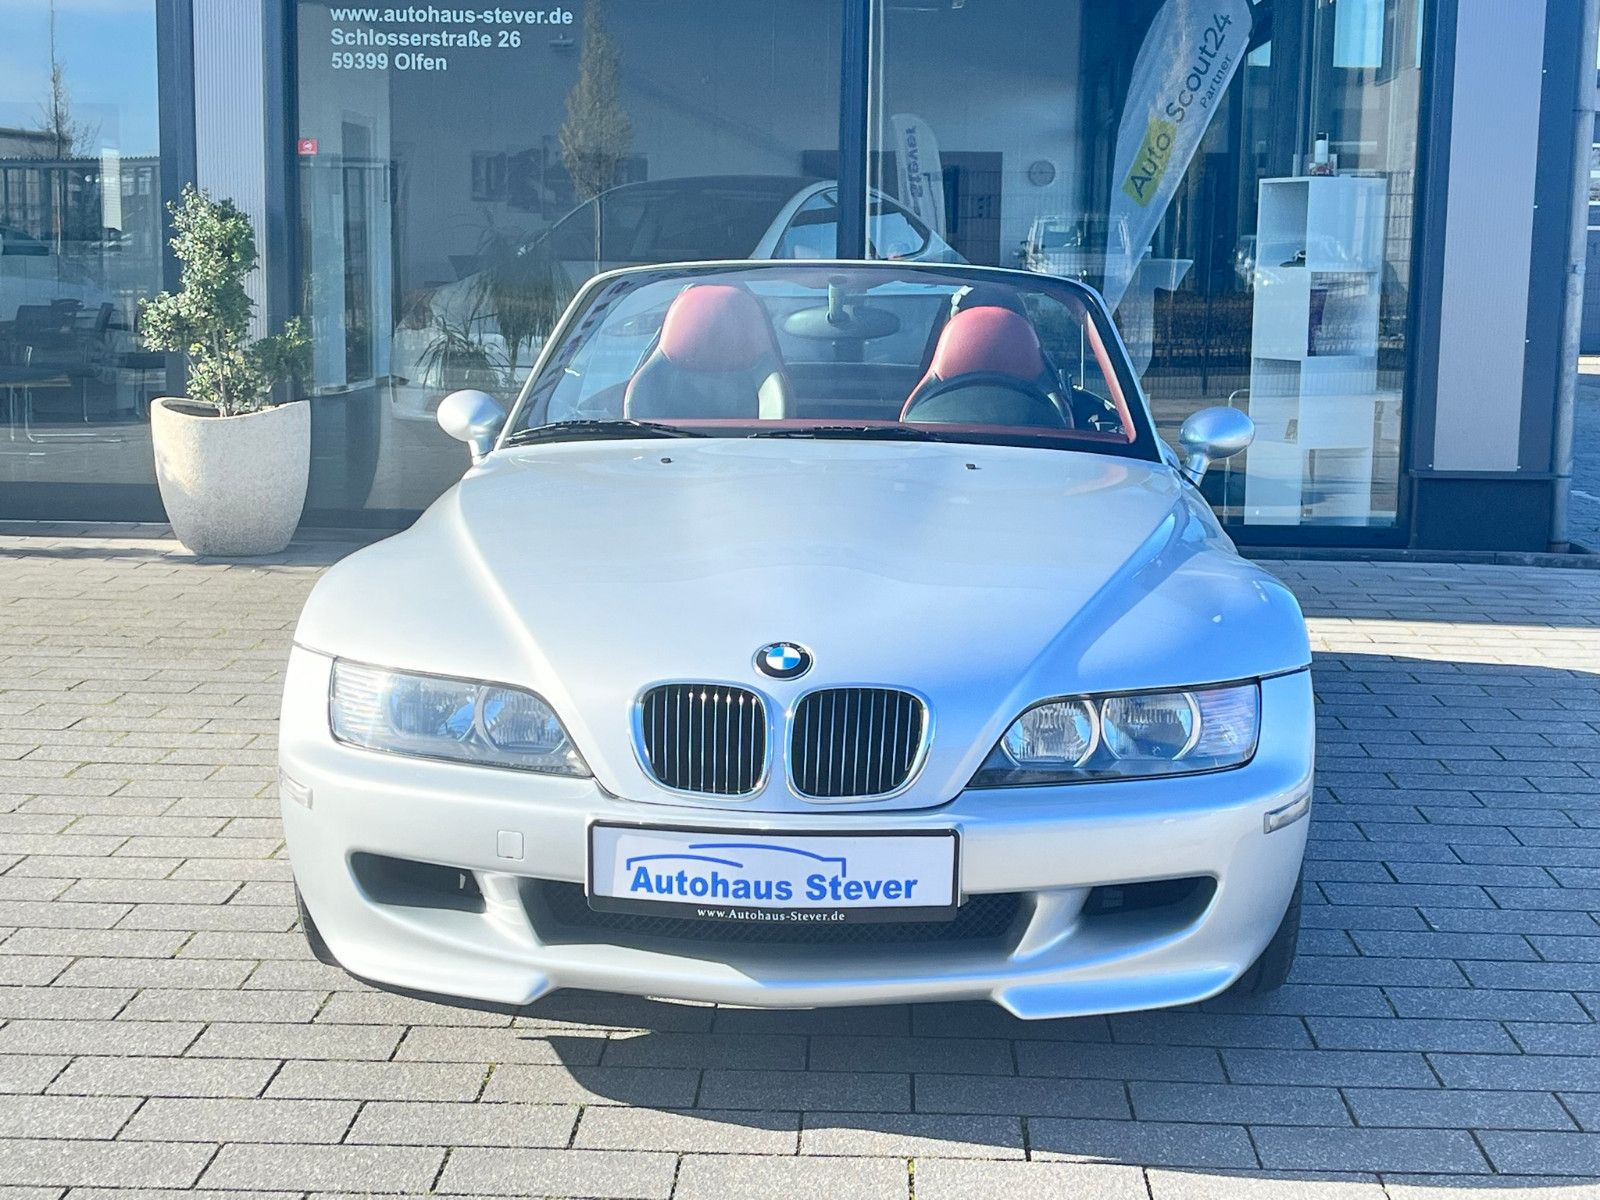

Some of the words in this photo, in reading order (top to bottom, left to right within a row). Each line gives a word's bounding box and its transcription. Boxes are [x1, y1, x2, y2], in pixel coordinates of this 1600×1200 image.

[330, 6, 573, 24] www.autohaus-stever.de
[330, 28, 492, 47] Schlosserstraße
[498, 31, 521, 48] 26
[331, 52, 388, 70] 59399
[394, 53, 447, 71] Olfen
[1200, 55, 1233, 109] Partner
[1130, 133, 1171, 198] Auto
[1165, 13, 1233, 124] Scout24
[630, 866, 793, 901] Autohaus
[805, 874, 918, 901] Stever
[697, 909, 846, 921] www.Autohaus-Stever.de
